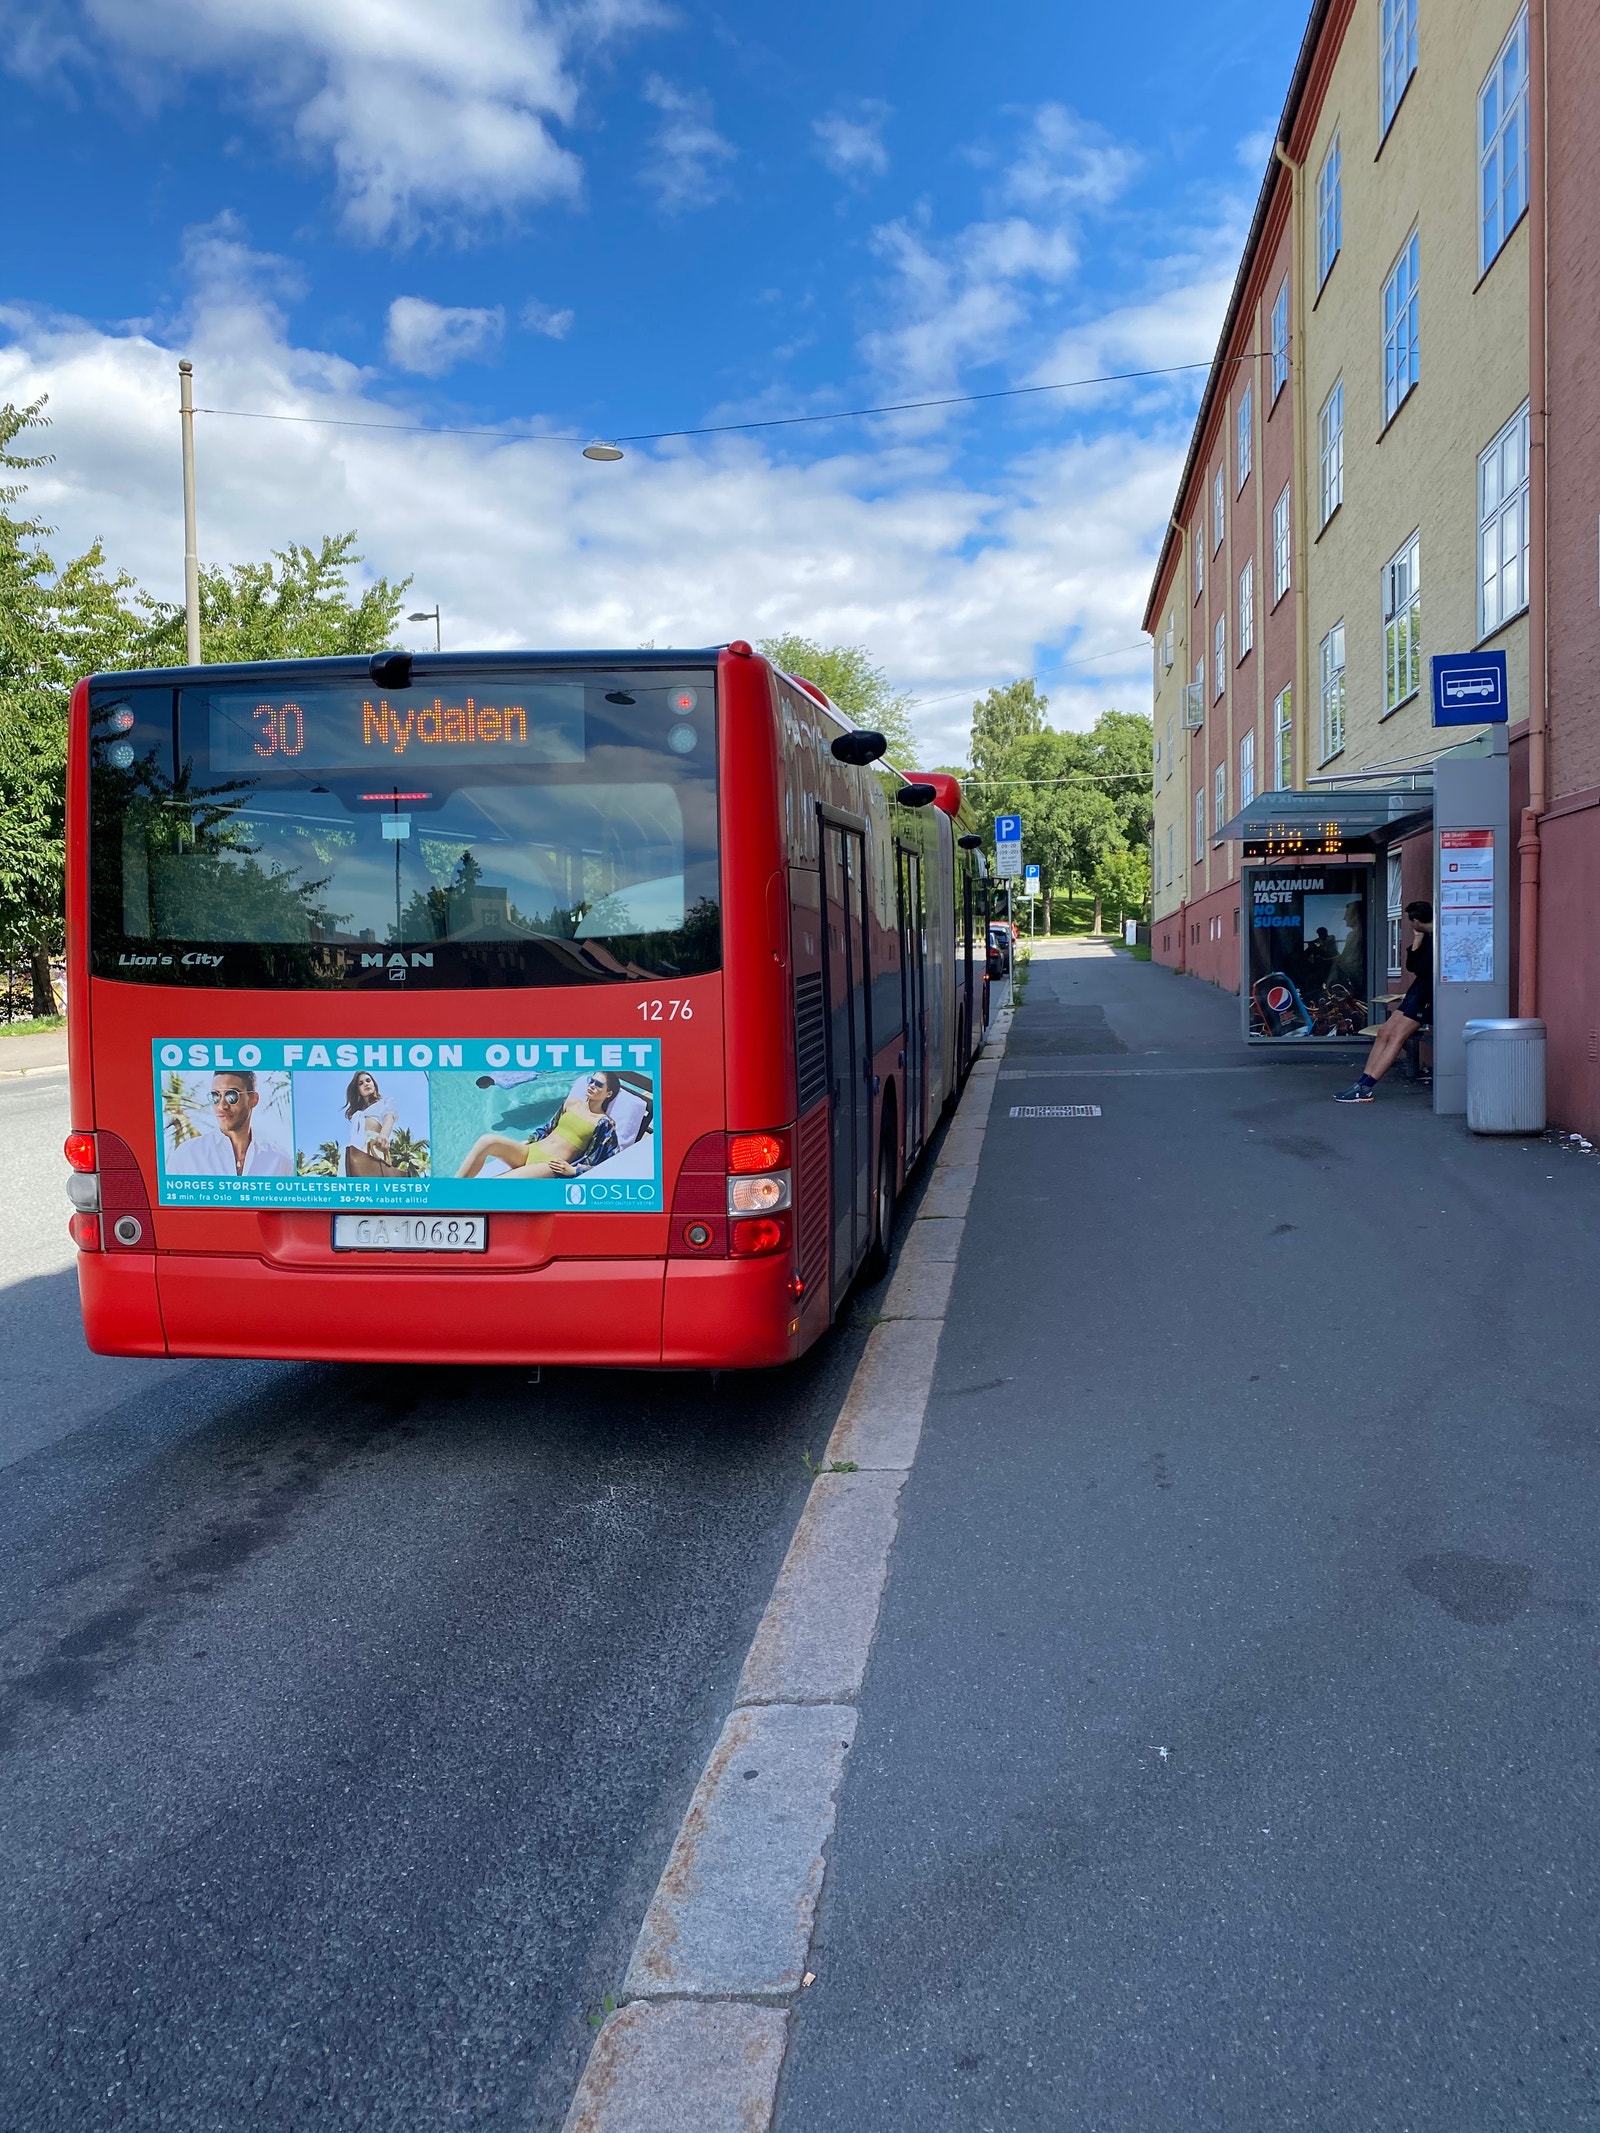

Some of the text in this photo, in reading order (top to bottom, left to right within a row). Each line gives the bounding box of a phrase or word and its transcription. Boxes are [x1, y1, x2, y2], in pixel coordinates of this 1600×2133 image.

[253, 698, 528, 757] 30 Nydalen
[1001, 819, 1015, 839] P
[1029, 867, 1036, 877] P
[1254, 879, 1324, 891] MAXIMUM
[1254, 892, 1292, 904] TASTE
[1254, 905, 1275, 915] NO
[1254, 916, 1301, 927] SUGAR
[118, 952, 225, 967] Lion's City
[361, 952, 434, 968] MAN
[159, 1043, 654, 1069] OSLO FASHION OUTLET
[166, 1180, 431, 1194] NORGES STØRSTE OUTLETSENTER I VESTBY
[590, 1184, 656, 1201] OSLO
[179, 1193, 197, 1201] min.
[199, 1193, 211, 1201] fra
[213, 1193, 232, 1202] Oslo
[252, 1194, 332, 1203] merkevarebutikker
[340, 1195, 374, 1204] 30-70%
[375, 1195, 403, 1204] rabatt
[405, 1196, 428, 1204] alltid
[355, 1219, 478, 1246] GA 10682
